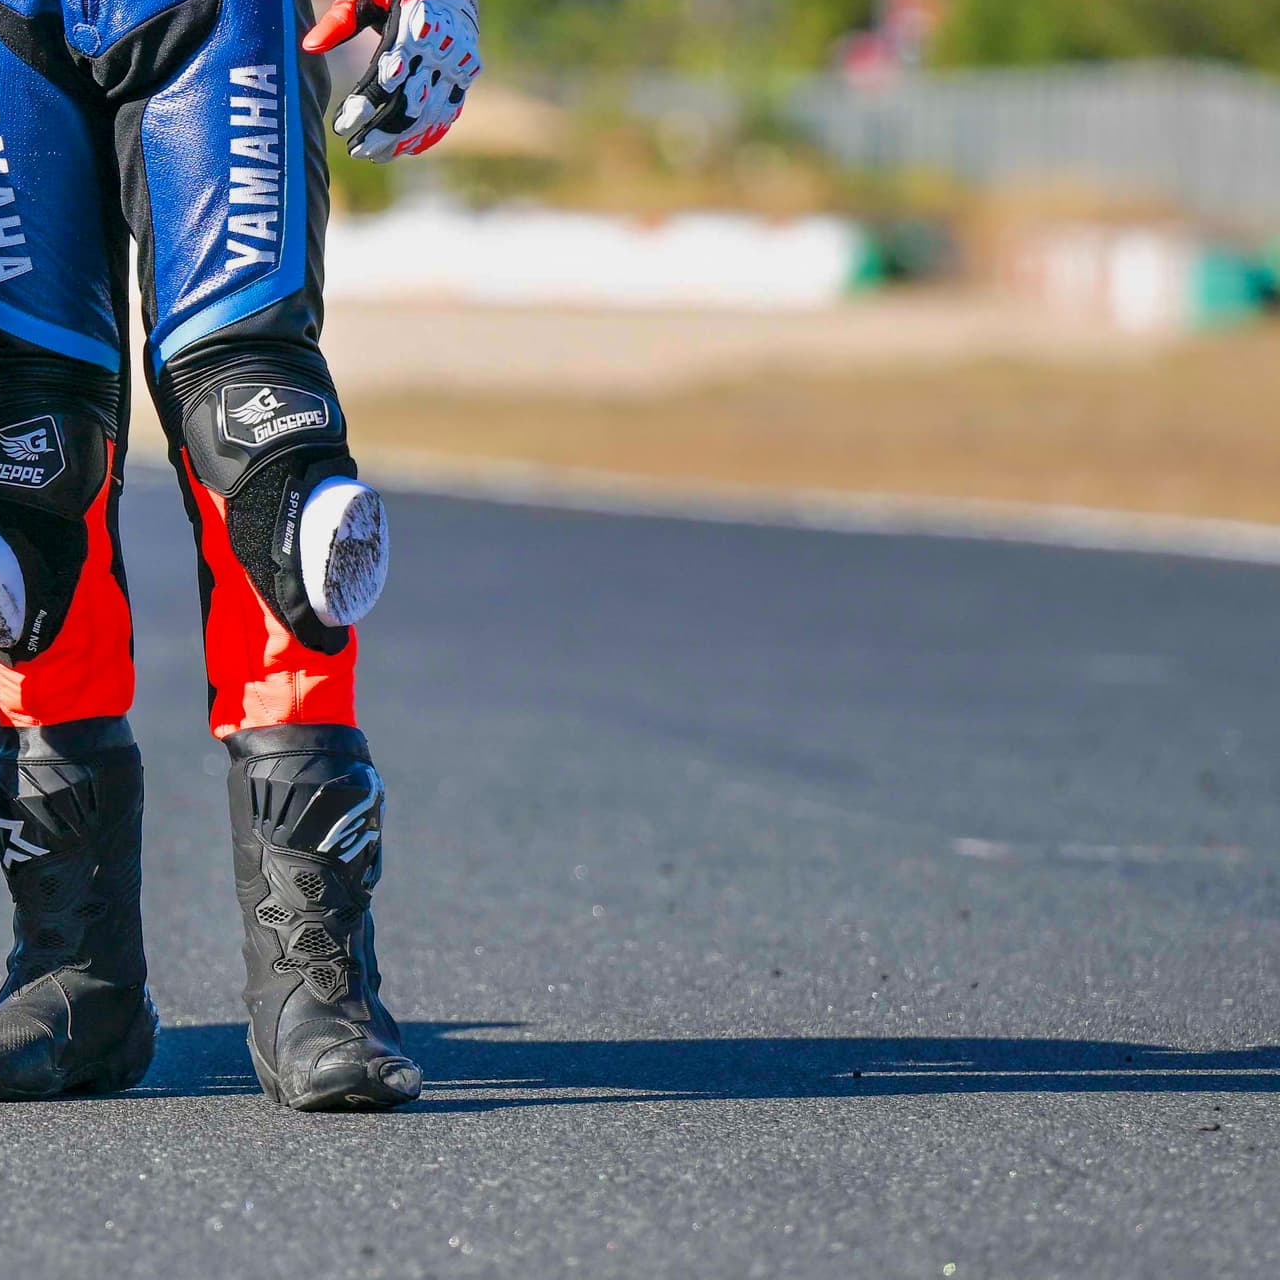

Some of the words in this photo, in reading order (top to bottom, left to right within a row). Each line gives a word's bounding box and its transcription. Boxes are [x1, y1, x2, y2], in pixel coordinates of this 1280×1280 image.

[224, 63, 280, 272] YAMAHA
[289, 491, 300, 524] SPN
[27, 634, 40, 653] SPN
